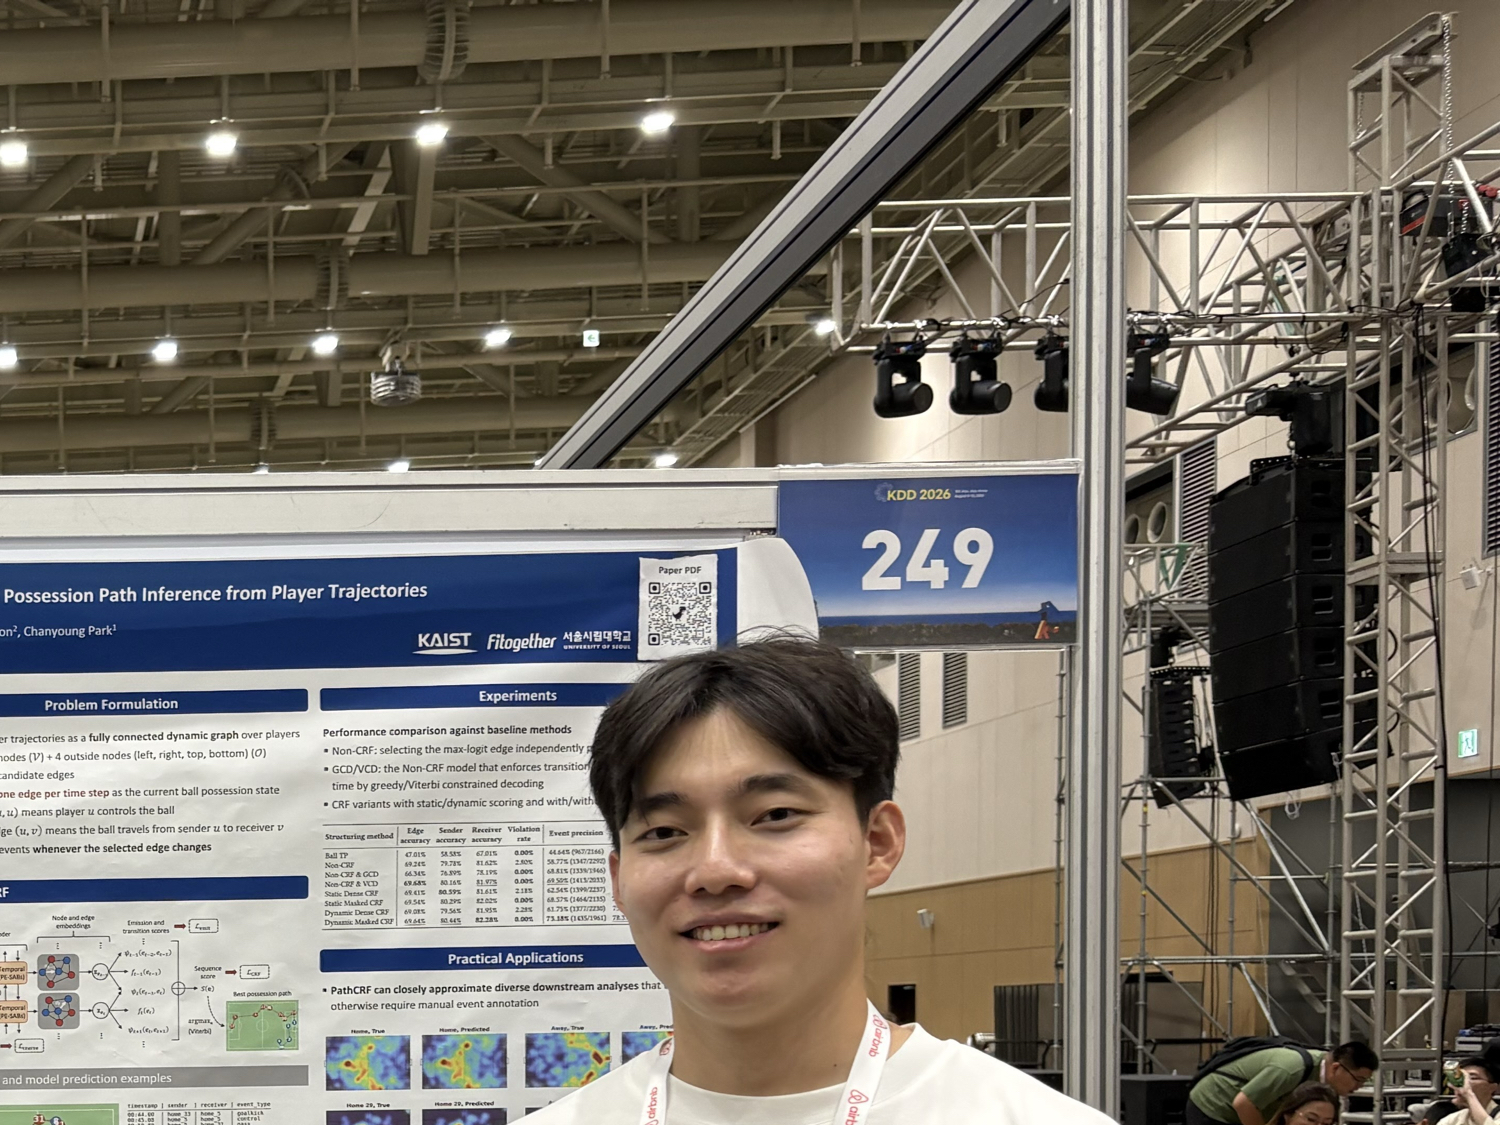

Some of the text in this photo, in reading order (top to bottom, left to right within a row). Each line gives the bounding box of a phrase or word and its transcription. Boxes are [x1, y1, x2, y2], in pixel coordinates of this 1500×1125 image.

[887, 490, 917, 501] KDD
[920, 488, 951, 500] 2026
[862, 528, 994, 591] 249
[658, 566, 702, 575] Paper PDF
[4, 588, 93, 603] Possession
[99, 586, 136, 602] Path
[142, 586, 221, 601] Inference
[225, 585, 266, 600] from
[271, 584, 324, 602] Player
[328, 583, 427, 601] Trajectories
[23, 626, 85, 638] Chanyoung
[563, 630, 631, 642] 서울시립대학교
[418, 632, 472, 647] KAIST
[479, 690, 557, 704] Experiments
[45, 698, 178, 711] Problem Formulation
[323, 724, 571, 737] Performance comparison against baseline methods
[448, 951, 583, 966] Practical Applications
[330, 998, 539, 1011] otherwise require manual event annotation
[868, 1027, 884, 1057] airbnb
[2, 1074, 22, 1085] and
[25, 1074, 59, 1085] model
[62, 1073, 117, 1086] prediction
[120, 1073, 171, 1085] examples
[647, 1086, 657, 1120] airbnb
